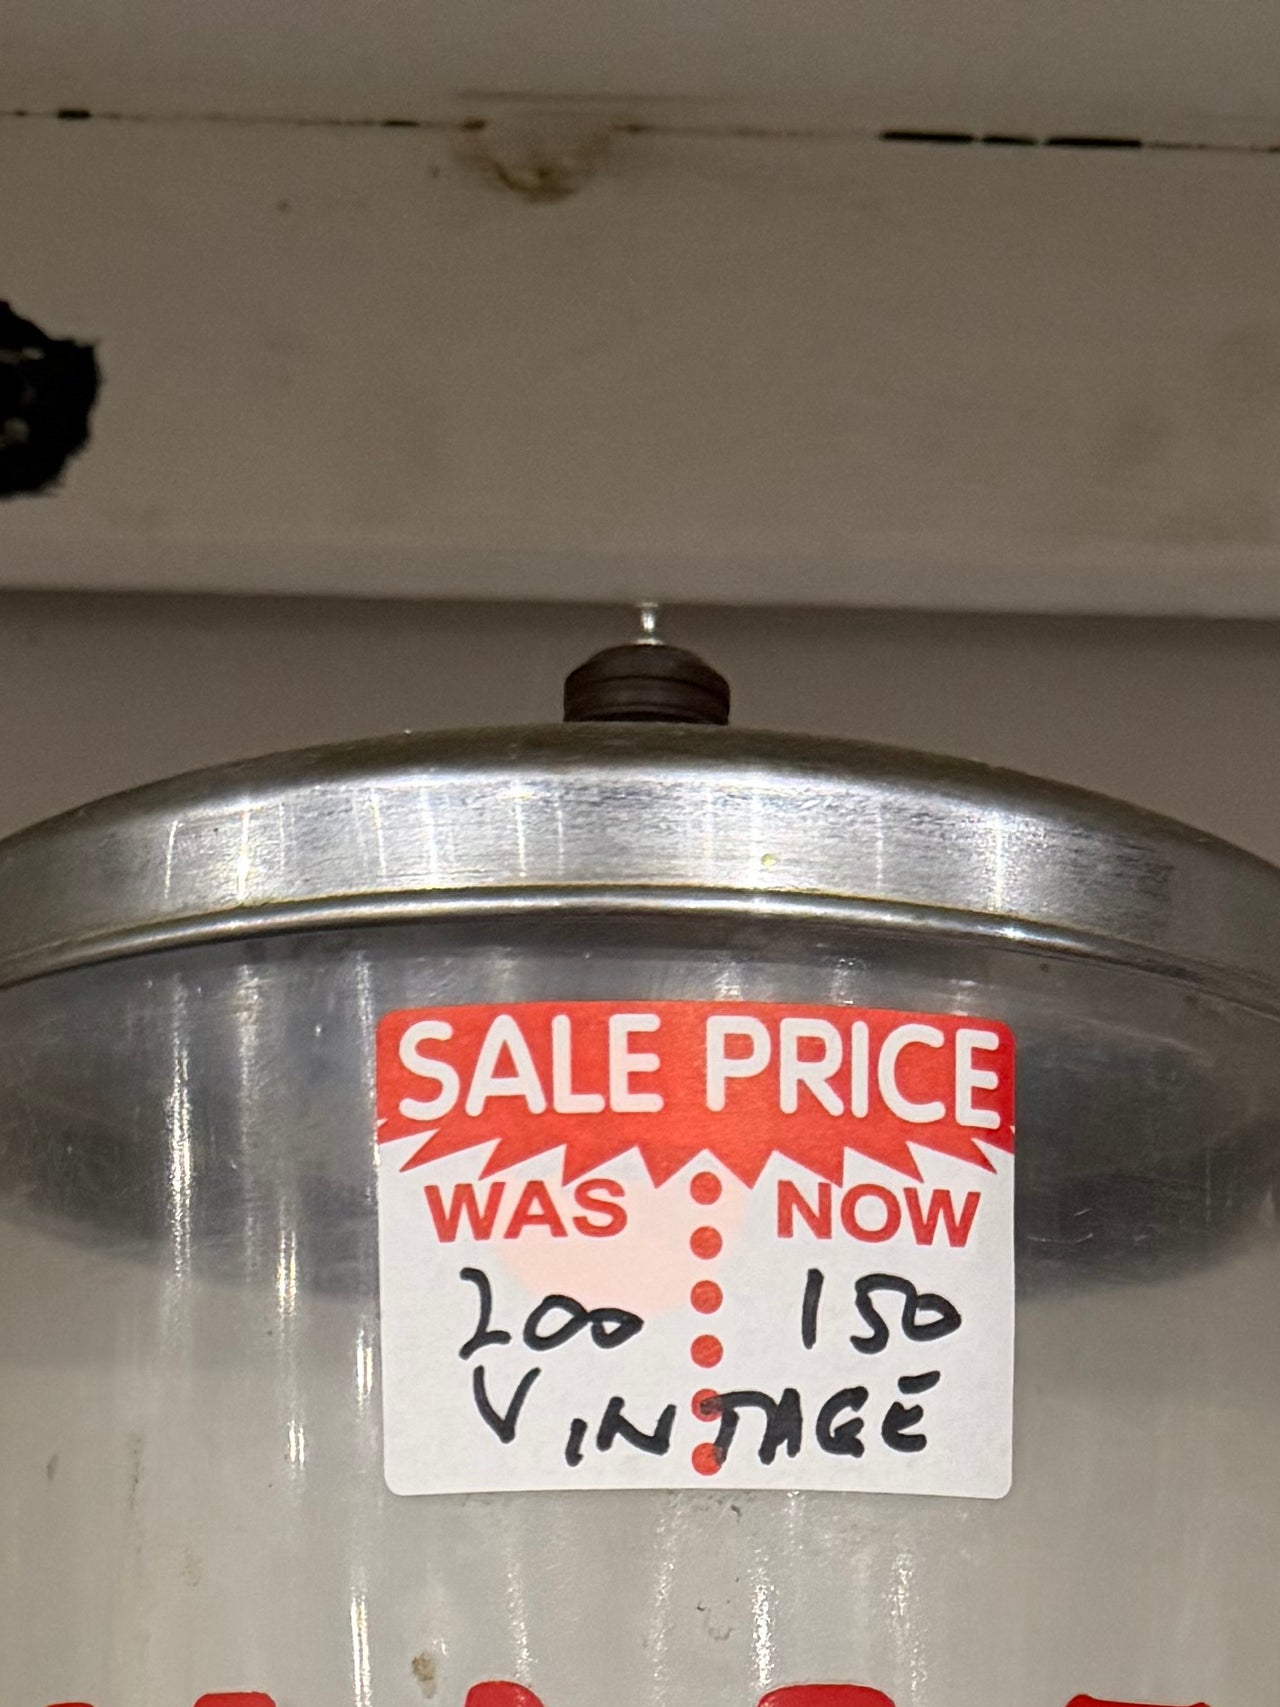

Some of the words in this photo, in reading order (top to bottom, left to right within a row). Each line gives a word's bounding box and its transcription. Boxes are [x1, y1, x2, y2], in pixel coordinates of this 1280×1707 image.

[398, 1012, 664, 1125] SALE
[705, 1015, 1001, 1130] PRICE
[423, 1178, 628, 1243] WAS
[776, 1179, 981, 1249] NOW
[459, 1266, 645, 1360] 200
[801, 1267, 962, 1354] 150
[472, 1365, 941, 1467] VINTAGE
